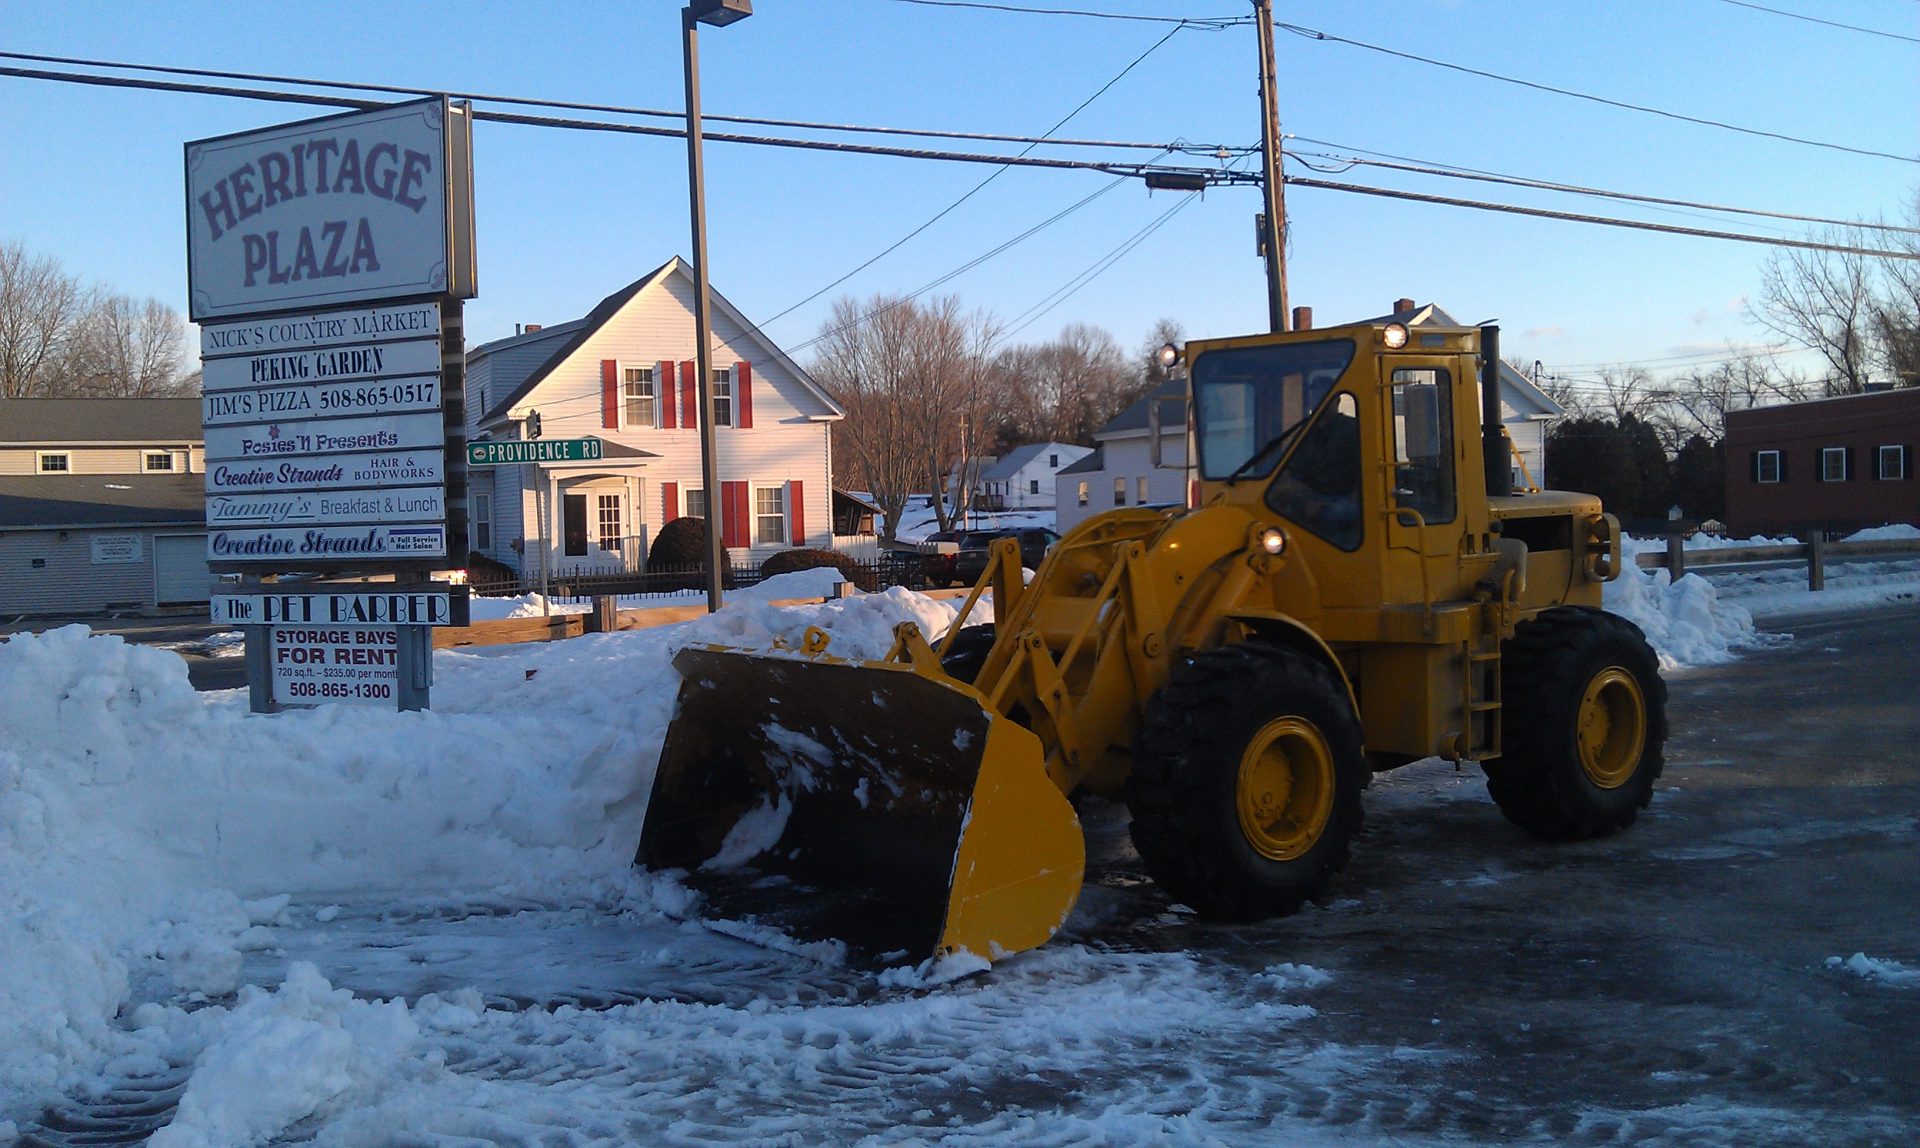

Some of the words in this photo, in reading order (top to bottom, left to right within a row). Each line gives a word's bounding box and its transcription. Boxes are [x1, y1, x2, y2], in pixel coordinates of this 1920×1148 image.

[198, 137, 432, 242] HERITAGE
[242, 217, 380, 288] PLAZA
[210, 327, 264, 348] NICK'S
[269, 318, 347, 341] COUNTRY
[354, 310, 431, 334] MARKET
[251, 354, 309, 382] PEKING
[316, 347, 383, 375] GARDEN
[208, 394, 252, 420] JIM'S
[258, 391, 311, 412] PIZZA
[319, 383, 434, 409] 508-865-0517
[242, 437, 296, 455] Posies
[316, 430, 398, 450] Presents
[489, 442, 569, 461] PROVIDENCE
[583, 441, 598, 458] RD
[214, 466, 274, 486] Creative
[277, 463, 344, 483] Strands
[354, 468, 434, 480] BODYWORKS
[371, 458, 399, 468] HAIR
[406, 457, 415, 466] &
[212, 496, 311, 523] Tammy's
[321, 498, 380, 514] Breakfast
[385, 499, 393, 512] &
[398, 496, 438, 512] Lunch
[213, 532, 296, 555] Creative
[300, 528, 386, 554] Strands
[398, 536, 410, 544] Full
[226, 599, 252, 619] The
[264, 595, 315, 622] PET
[330, 595, 448, 623] BARBER
[276, 630, 350, 644] STORAGE
[356, 631, 397, 644] BAYS
[277, 648, 325, 663] FOR
[335, 648, 398, 665] RENT
[277, 668, 292, 676] 720
[323, 668, 356, 678] $235.00
[358, 669, 372, 679] per
